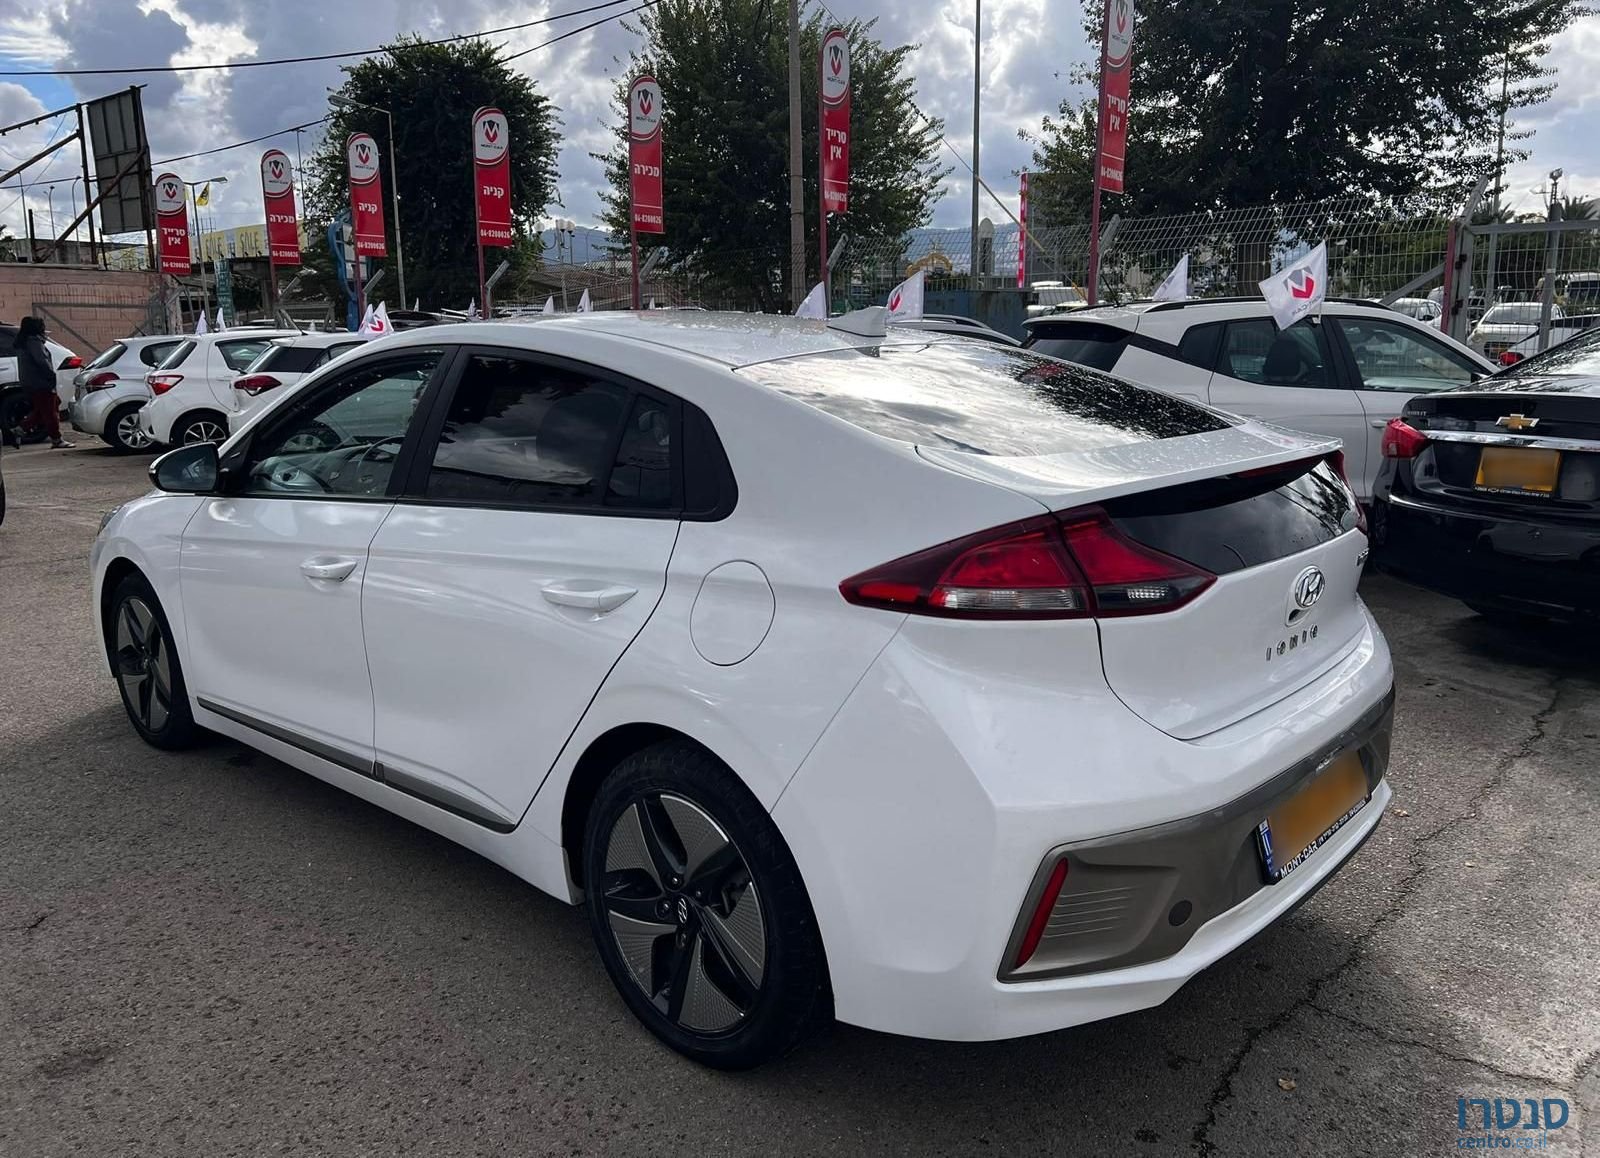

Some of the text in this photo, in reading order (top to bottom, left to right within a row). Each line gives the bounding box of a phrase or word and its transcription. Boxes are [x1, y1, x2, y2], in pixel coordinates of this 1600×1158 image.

[1107, 95, 1126, 114] סרייד
[1110, 113, 1120, 131] אין
[826, 128, 847, 144] סרייד
[830, 145, 842, 160] אין
[634, 163, 660, 177] מכירה
[483, 185, 504, 199] קניה
[358, 202, 378, 214] קניה
[269, 214, 295, 224] מכירה
[161, 227, 186, 237] סרייד
[168, 236, 181, 246] אין
[1280, 841, 1318, 878] MONT-CAR
